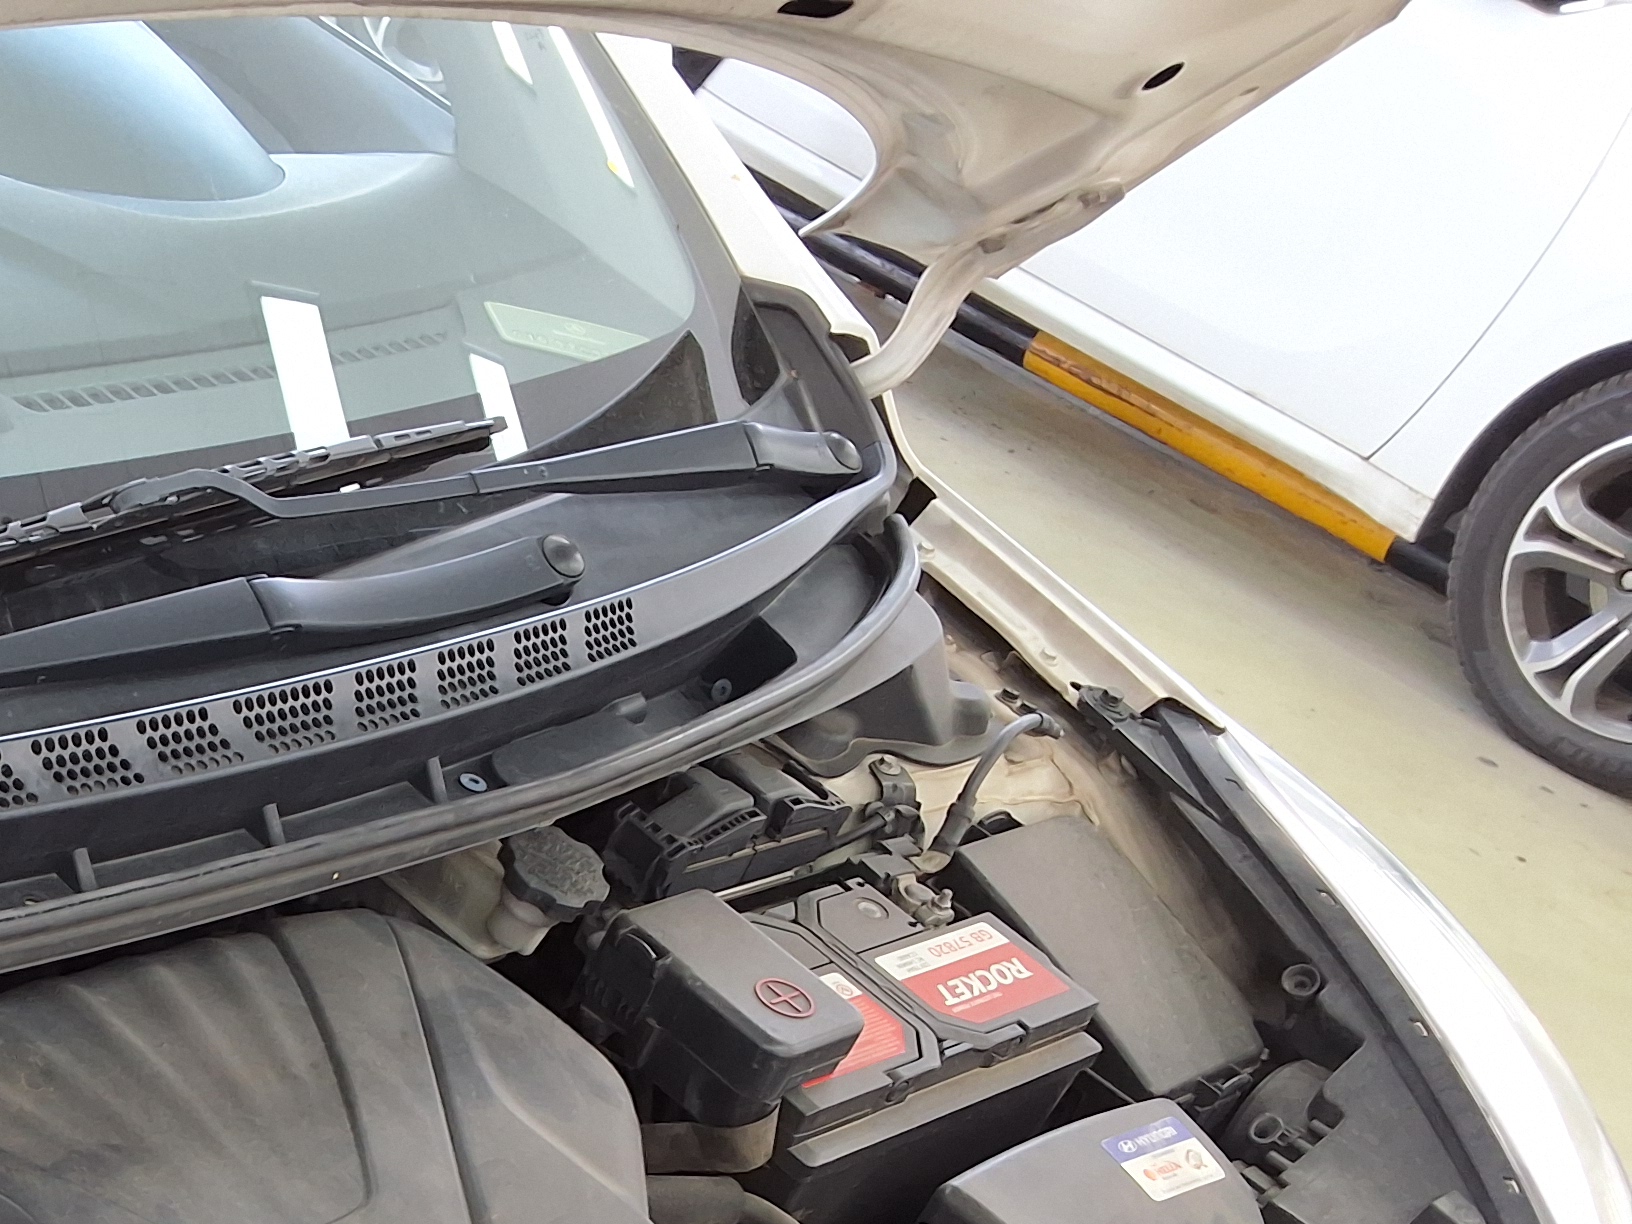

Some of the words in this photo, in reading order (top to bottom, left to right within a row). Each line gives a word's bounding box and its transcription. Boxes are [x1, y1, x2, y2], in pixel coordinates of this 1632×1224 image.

[970, 928, 994, 944] GB
[927, 938, 973, 958] 57820
[936, 956, 1034, 1006] ROCKET
